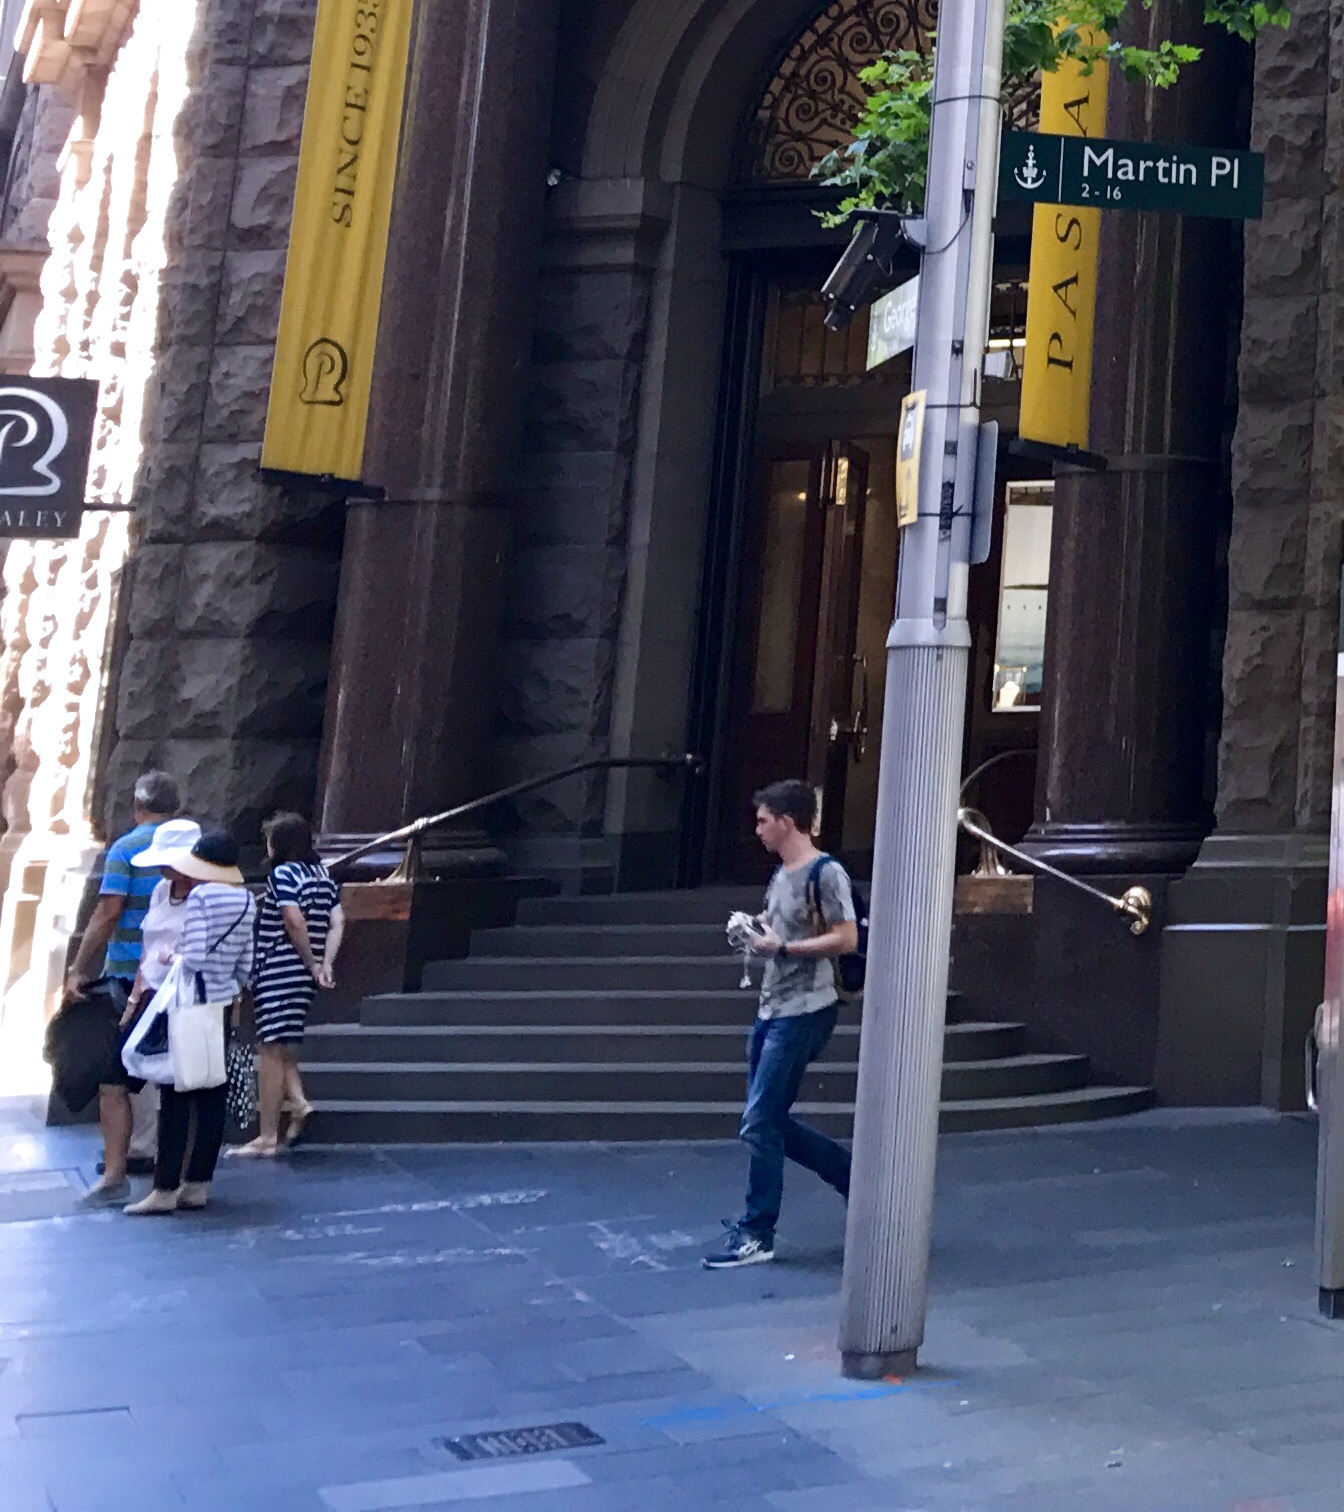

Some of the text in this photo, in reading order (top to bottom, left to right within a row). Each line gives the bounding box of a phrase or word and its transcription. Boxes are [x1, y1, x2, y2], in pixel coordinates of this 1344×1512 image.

[332, 85, 370, 228] SINCE
[1082, 145, 1239, 188] Martin Pl
